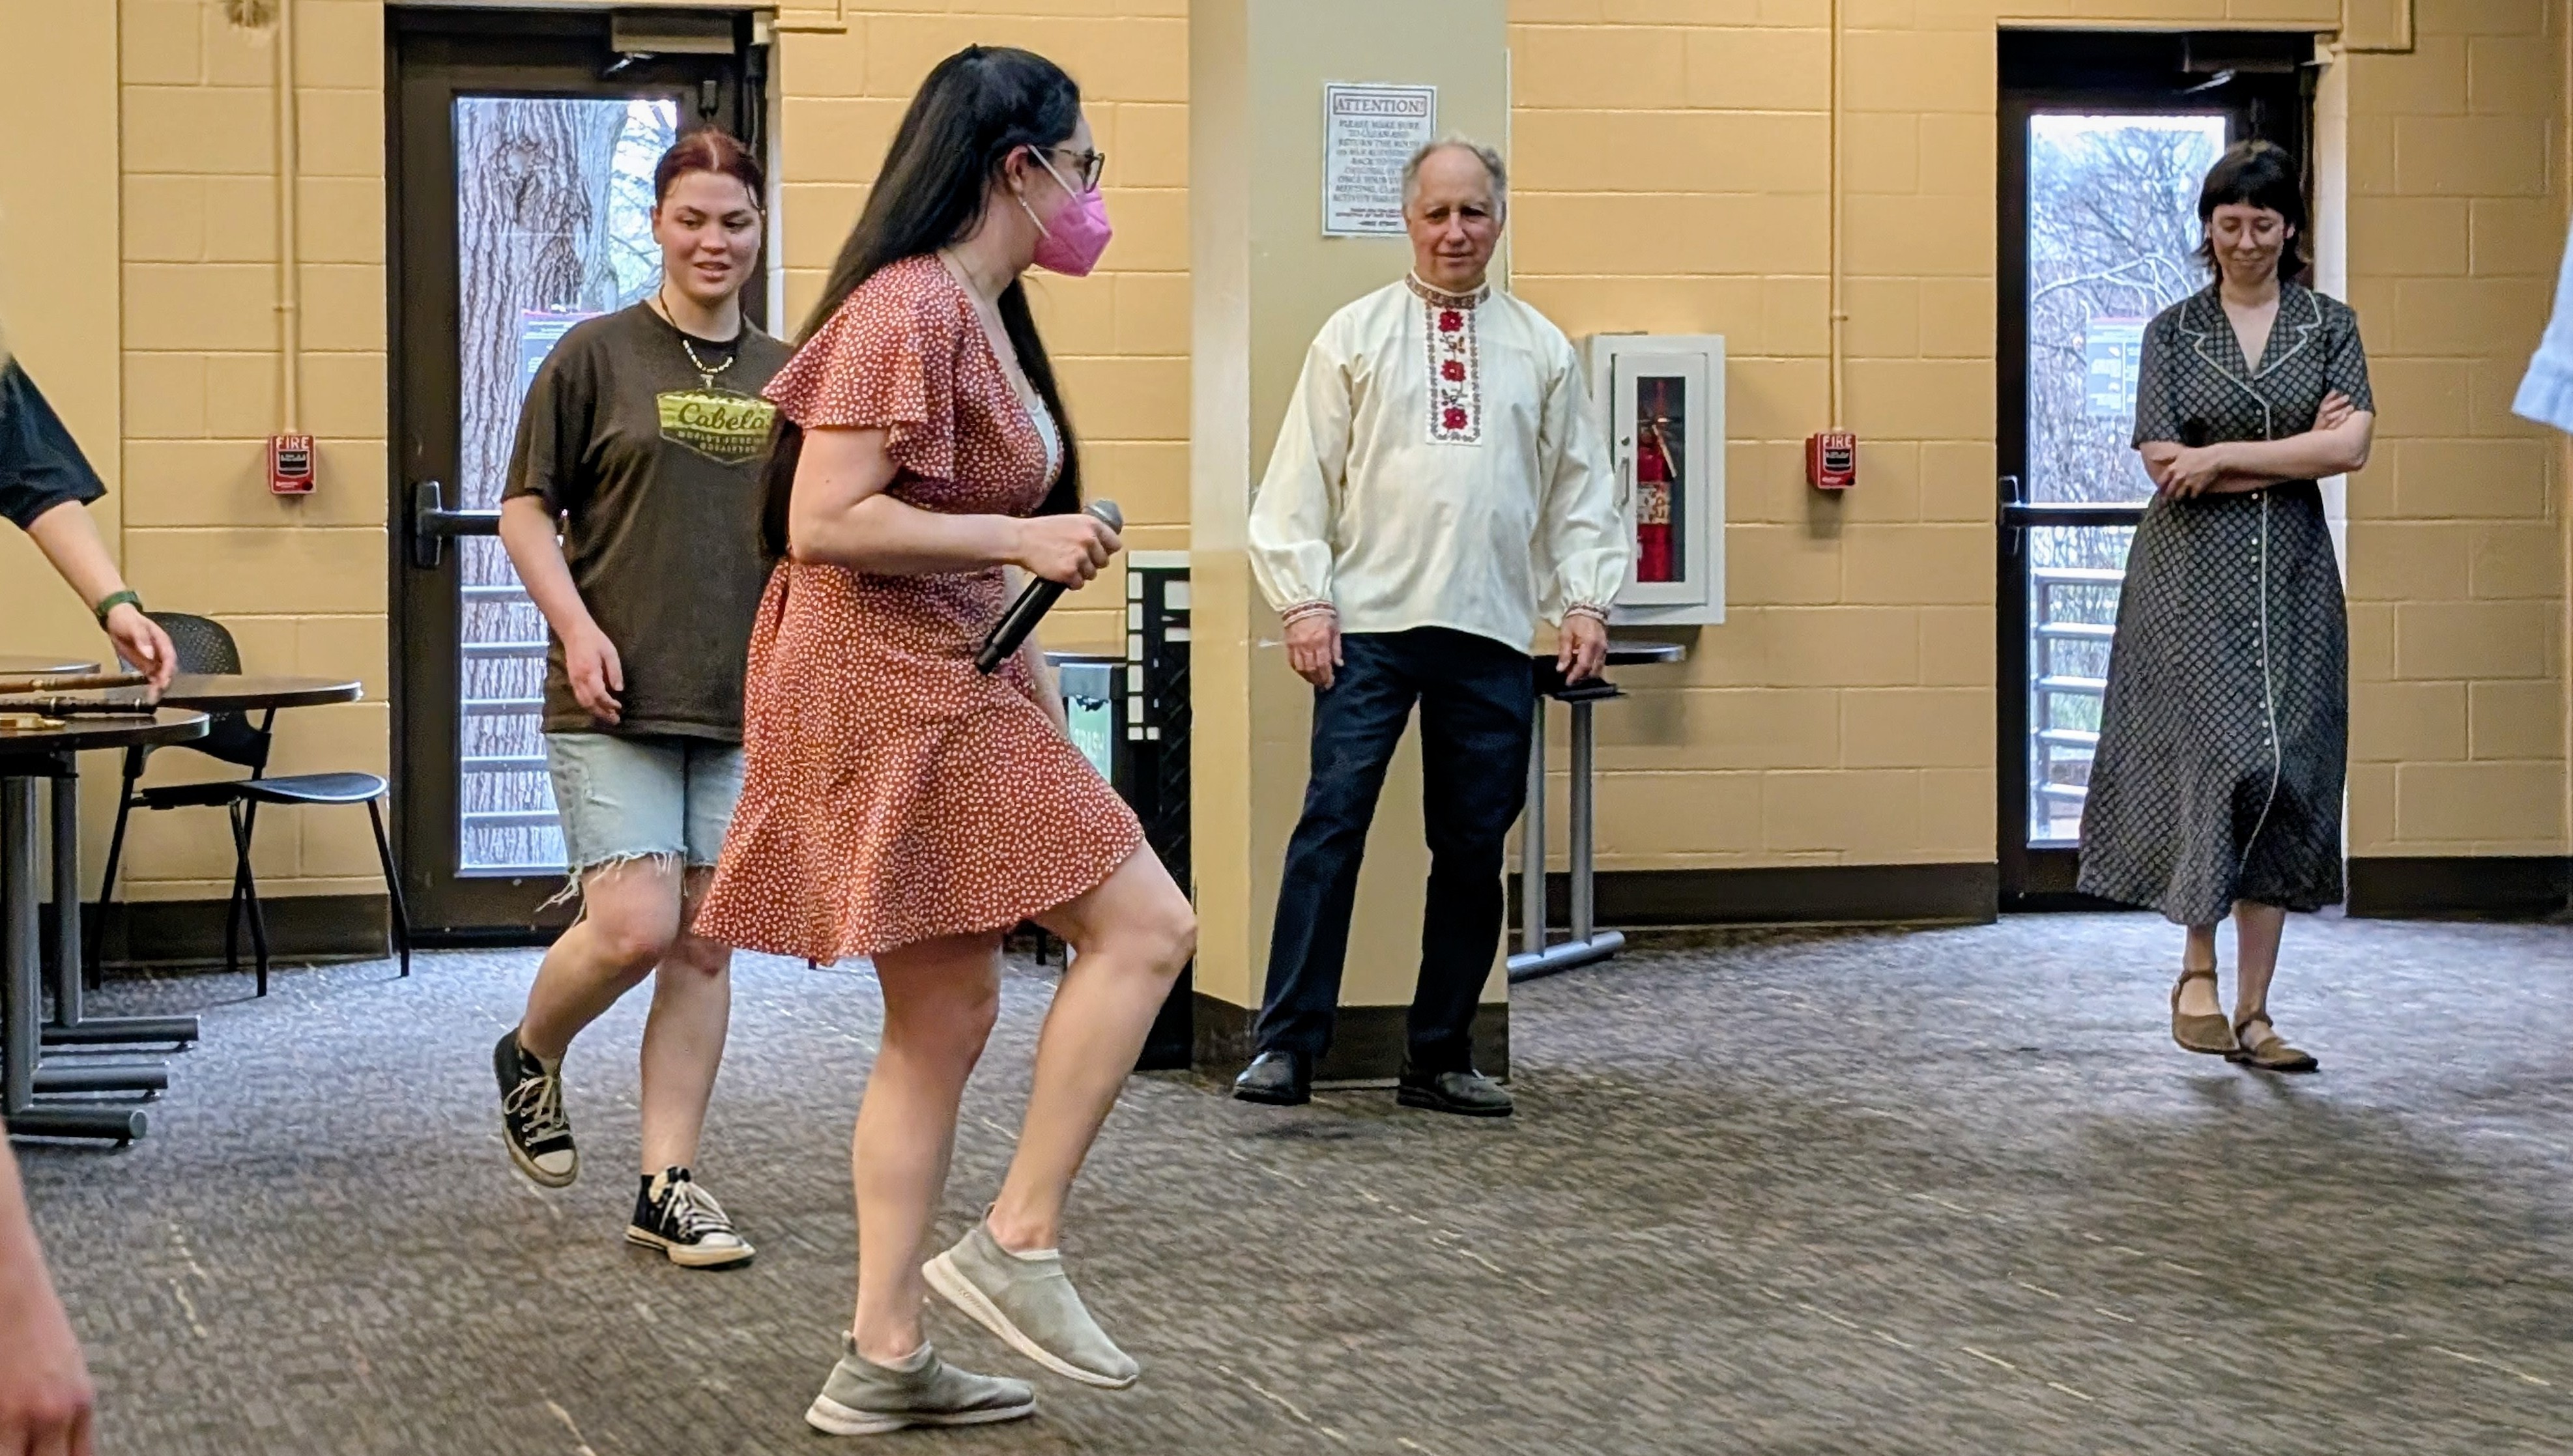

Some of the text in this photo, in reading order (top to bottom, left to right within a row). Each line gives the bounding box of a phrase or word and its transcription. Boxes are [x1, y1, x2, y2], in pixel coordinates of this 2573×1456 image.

[1336, 98, 1424, 113] ATTENTION!
[276, 436, 309, 450] FIRE
[1823, 435, 1852, 448] FIRE
